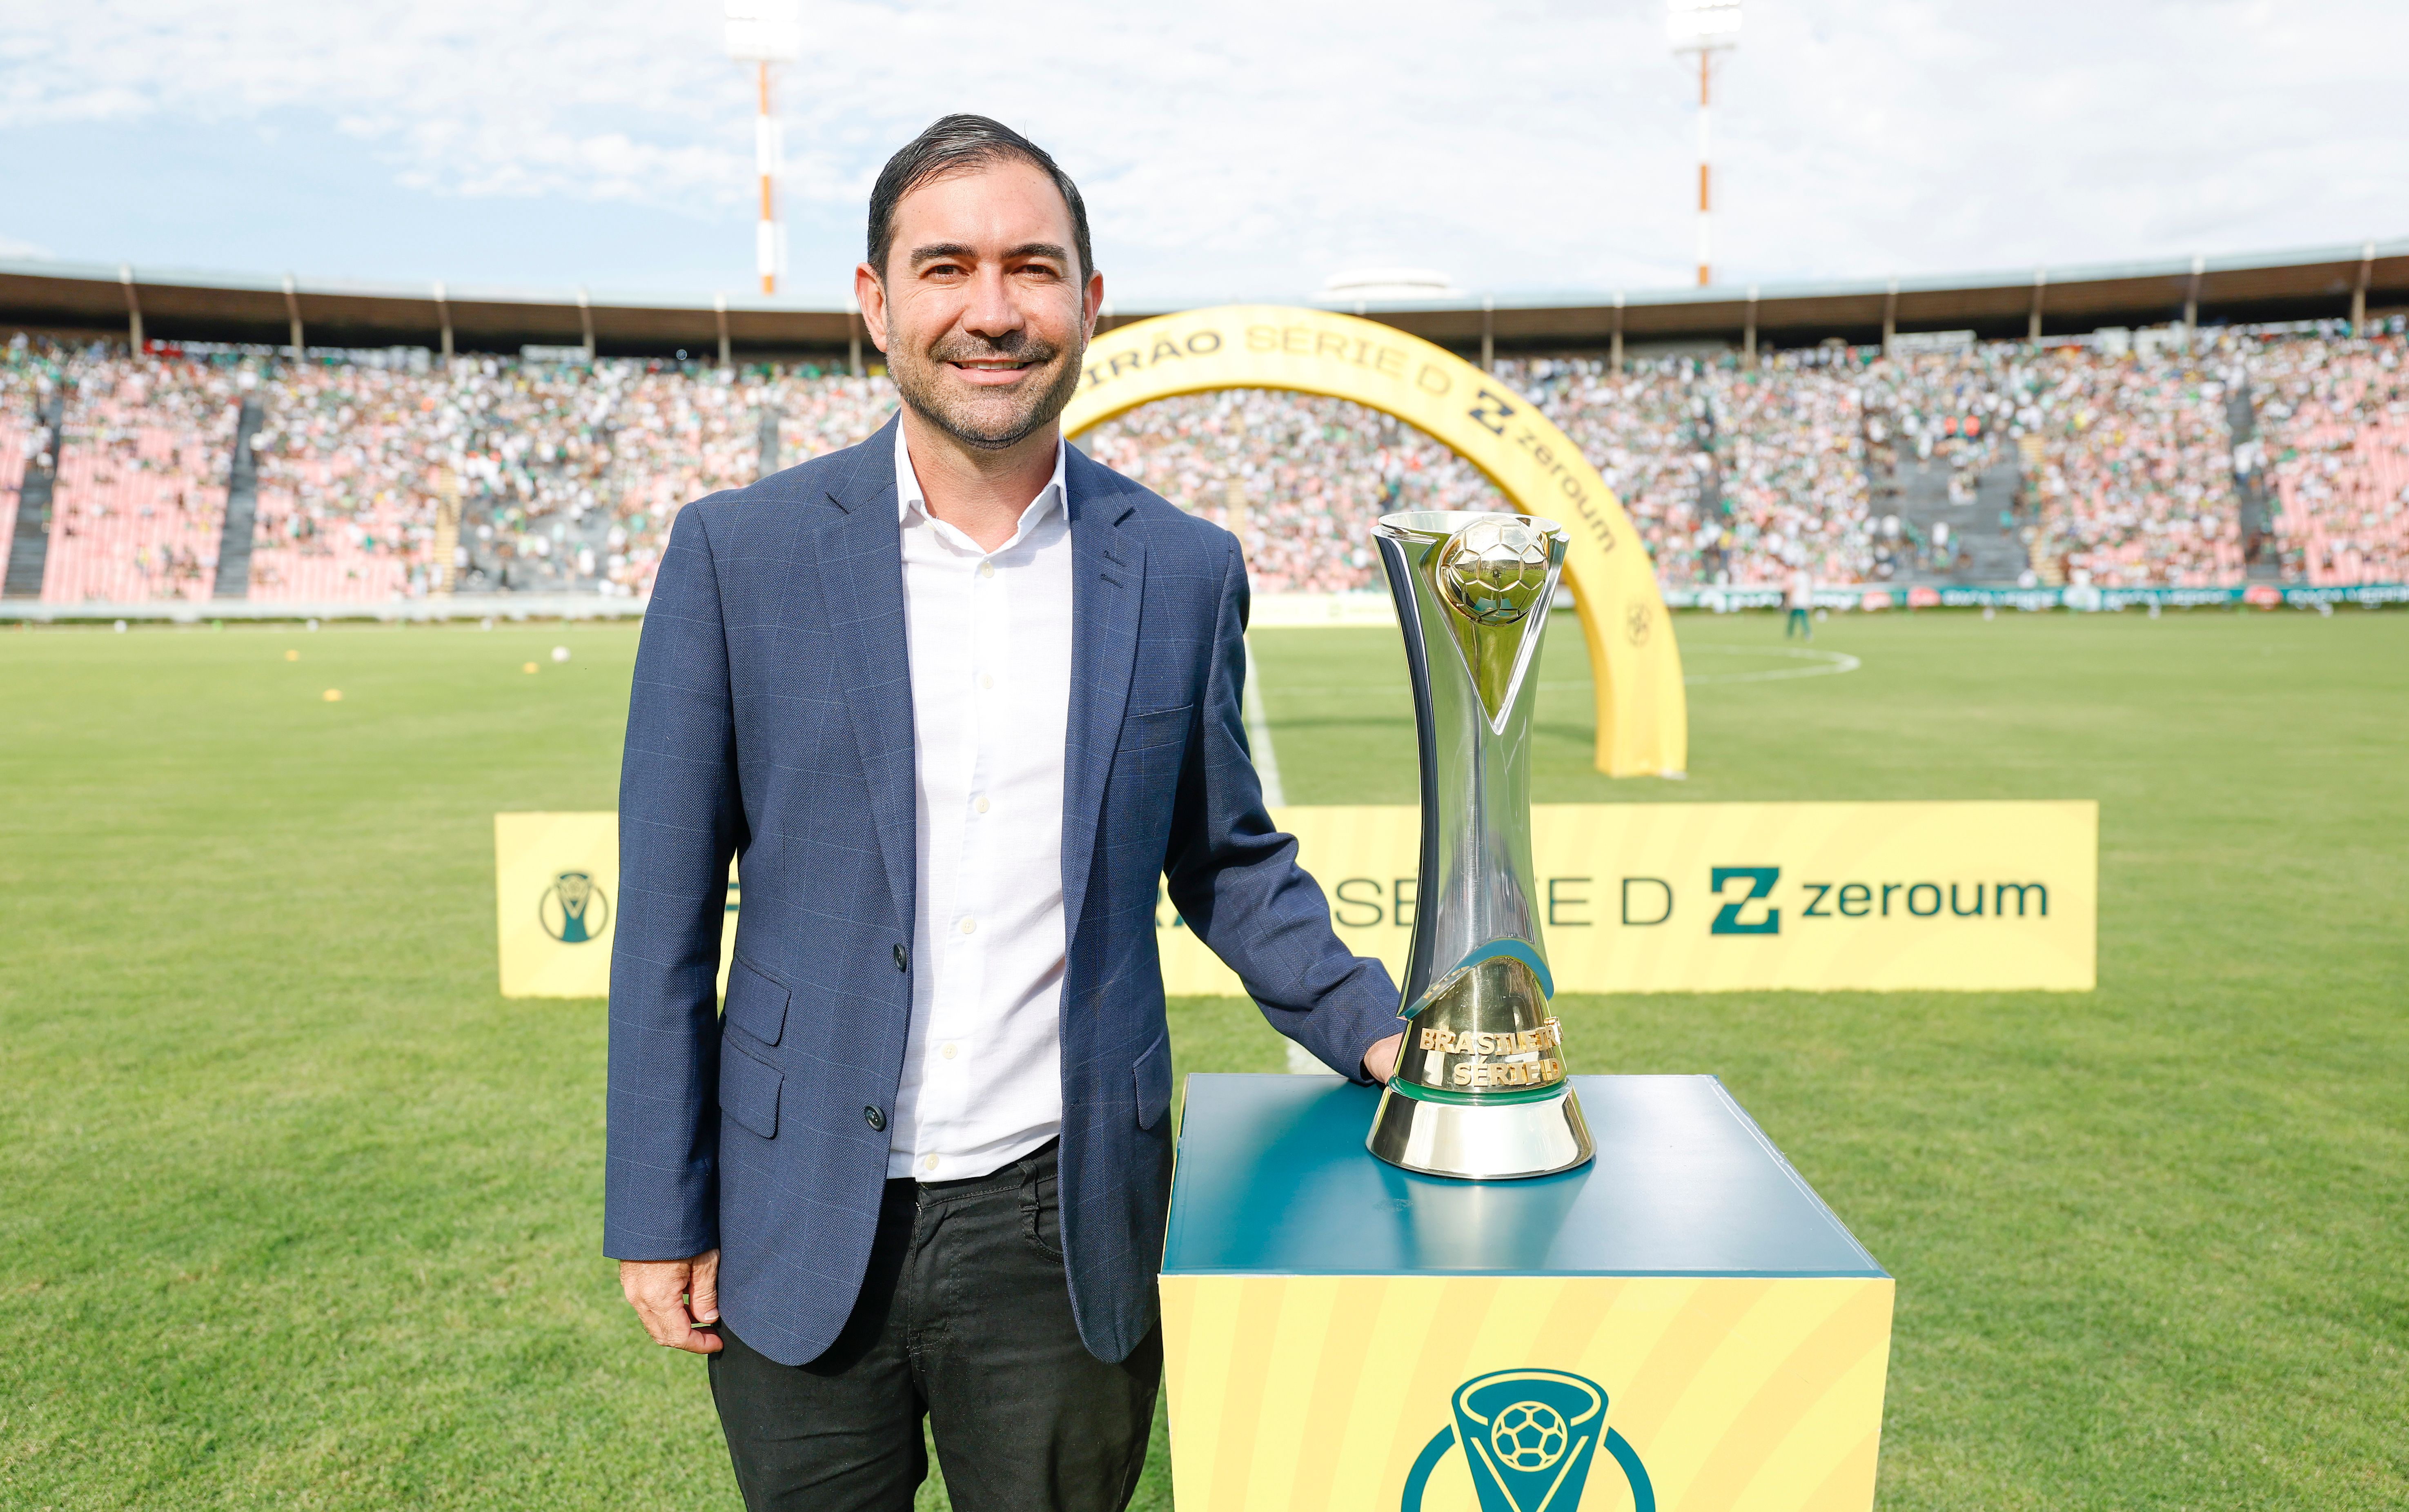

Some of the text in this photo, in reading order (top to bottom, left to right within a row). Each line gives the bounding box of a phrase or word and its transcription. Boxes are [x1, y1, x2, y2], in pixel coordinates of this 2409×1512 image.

[1080, 330, 1223, 389] IRÃO
[1416, 362, 1453, 397] D
[1517, 426, 1617, 553] zeroum
[1622, 877, 1673, 926] D
[1802, 883, 2048, 917] zeroum
[1419, 1016, 1564, 1056] BRASILEIR
[1454, 1056, 1562, 1087] SÉRIE D
